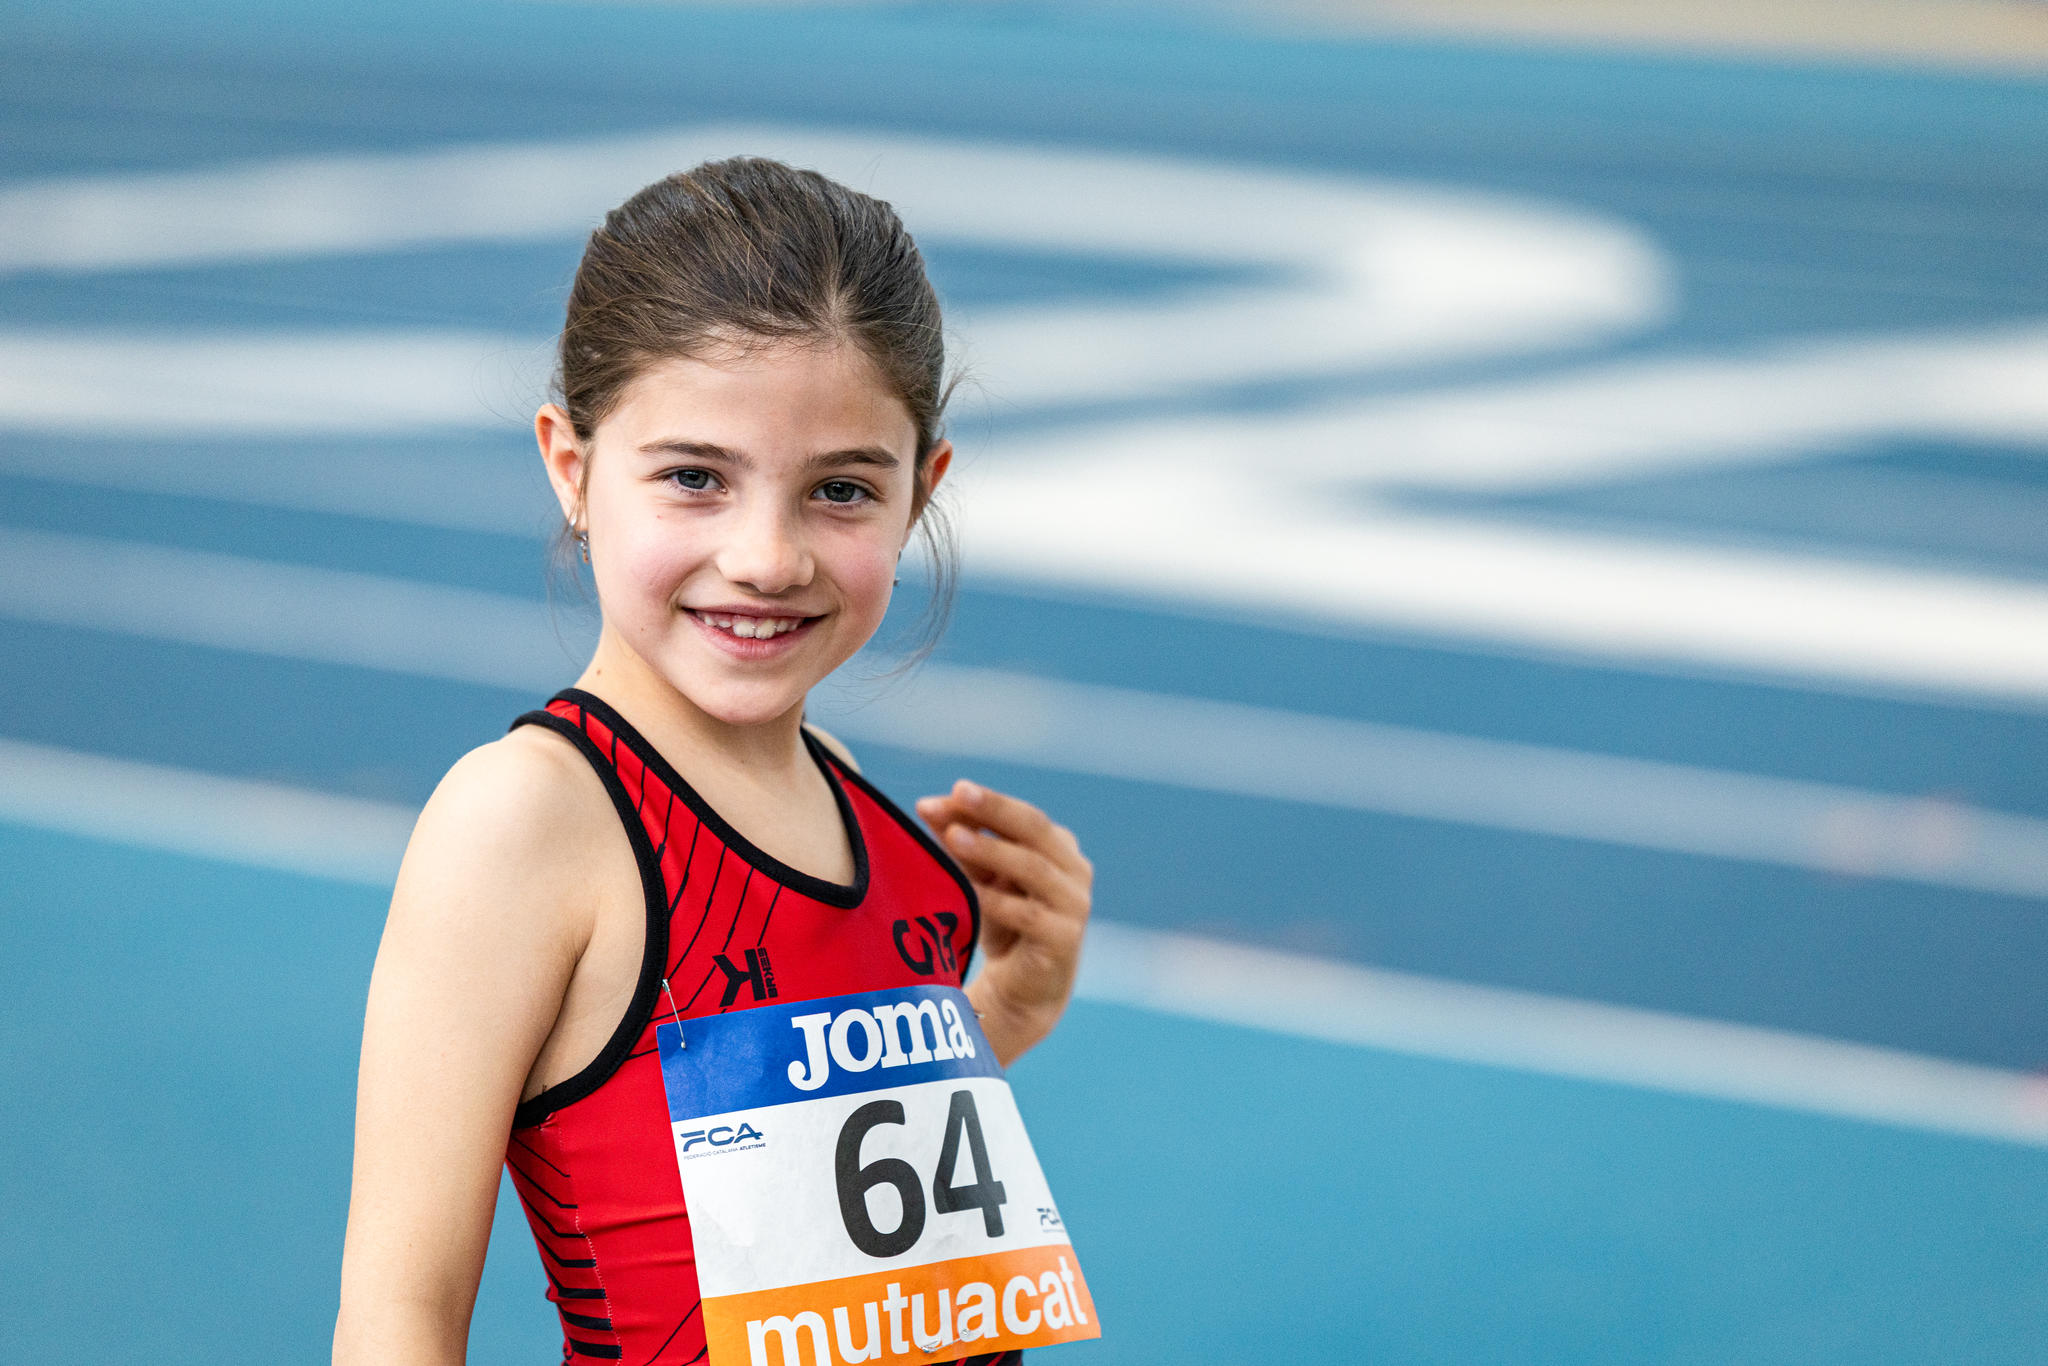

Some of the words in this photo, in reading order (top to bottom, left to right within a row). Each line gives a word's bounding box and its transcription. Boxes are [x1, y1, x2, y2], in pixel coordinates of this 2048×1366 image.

[681, 1123, 764, 1152] FCA
[739, 1142, 766, 1151] ATLETISME
[834, 1090, 1007, 1258] 64
[746, 1256, 1088, 1366] mutuacat
